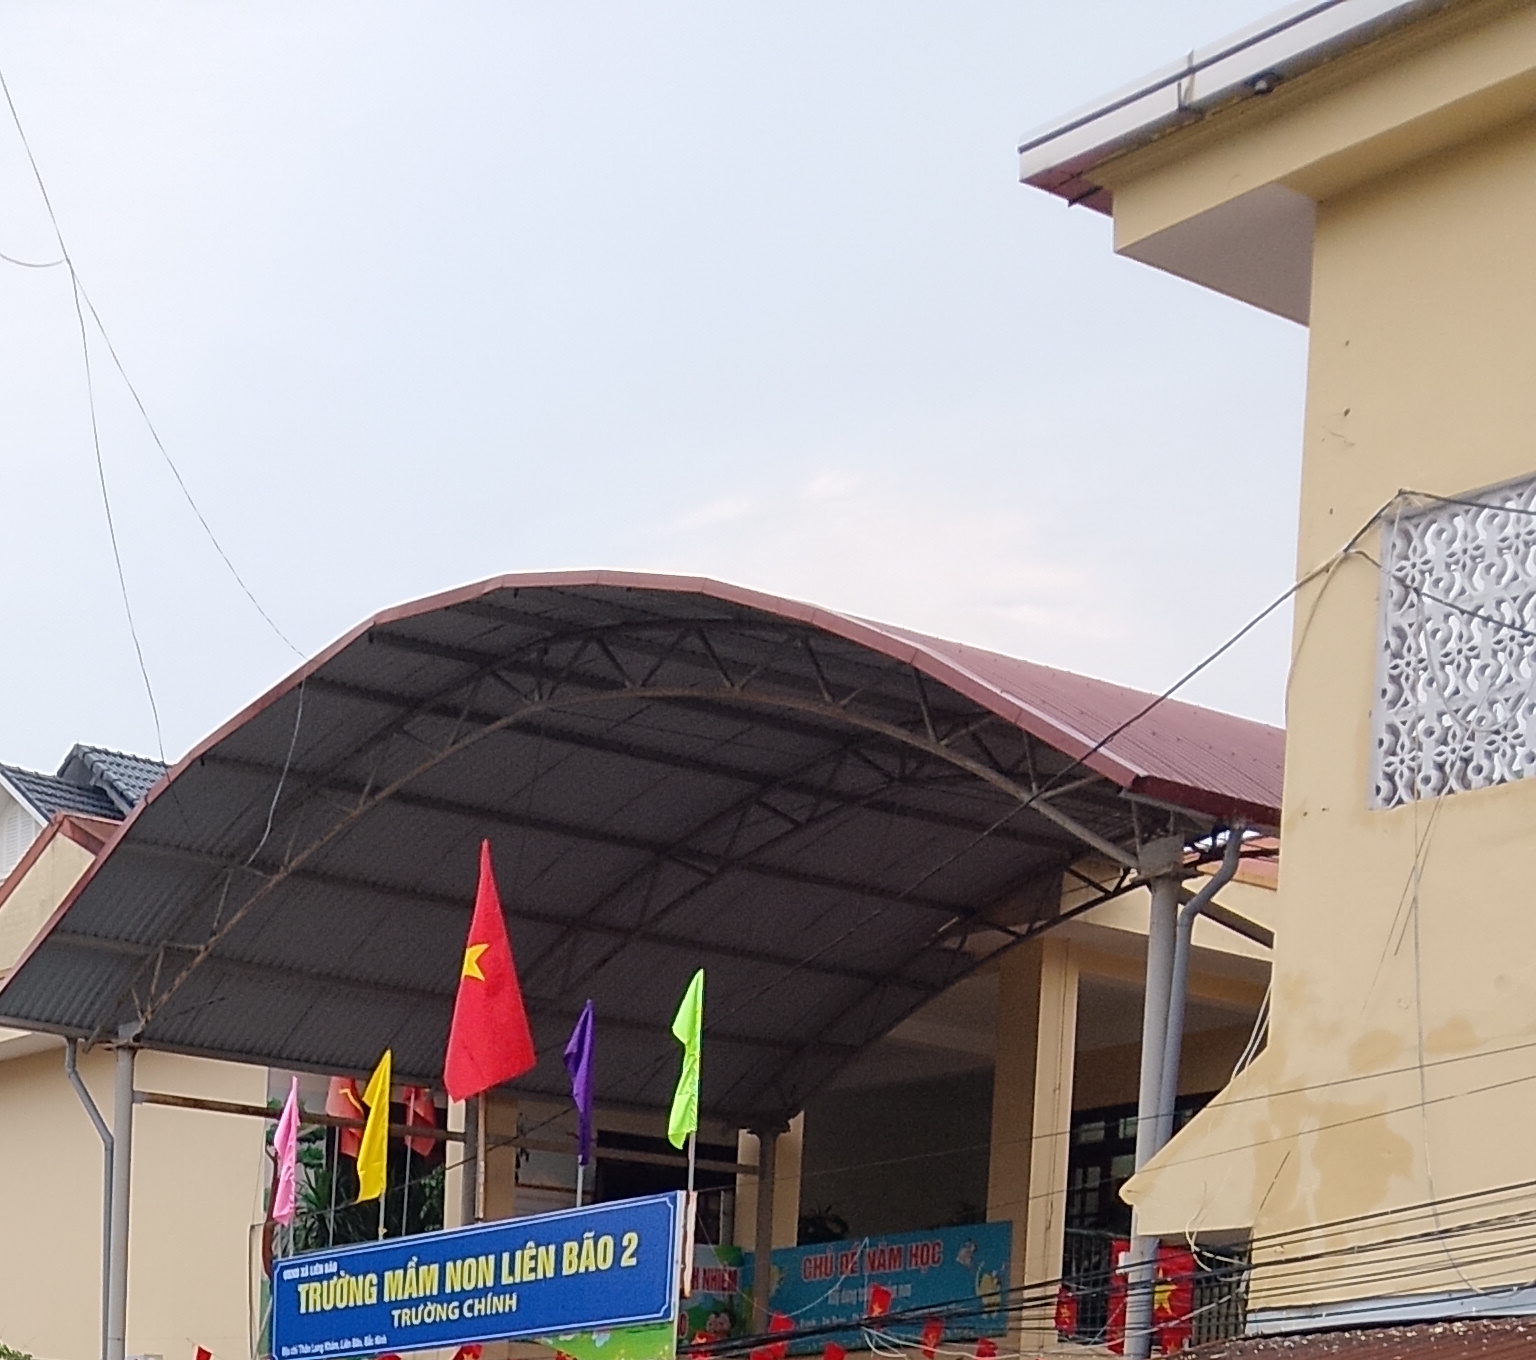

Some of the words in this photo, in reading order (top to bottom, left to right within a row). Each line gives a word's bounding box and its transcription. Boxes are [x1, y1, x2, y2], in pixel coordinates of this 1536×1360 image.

[297, 1270, 378, 1314] TRƯỜNG
[383, 1256, 439, 1303] MẦM
[445, 1254, 495, 1294] NON
[501, 1240, 556, 1285] LIÊN
[562, 1231, 615, 1276] BÃO
[620, 1231, 639, 1267] 2
[907, 1241, 944, 1274] HỌC
[391, 1301, 460, 1329] TRƯỜNG
[463, 1292, 517, 1318] CHÍNH
